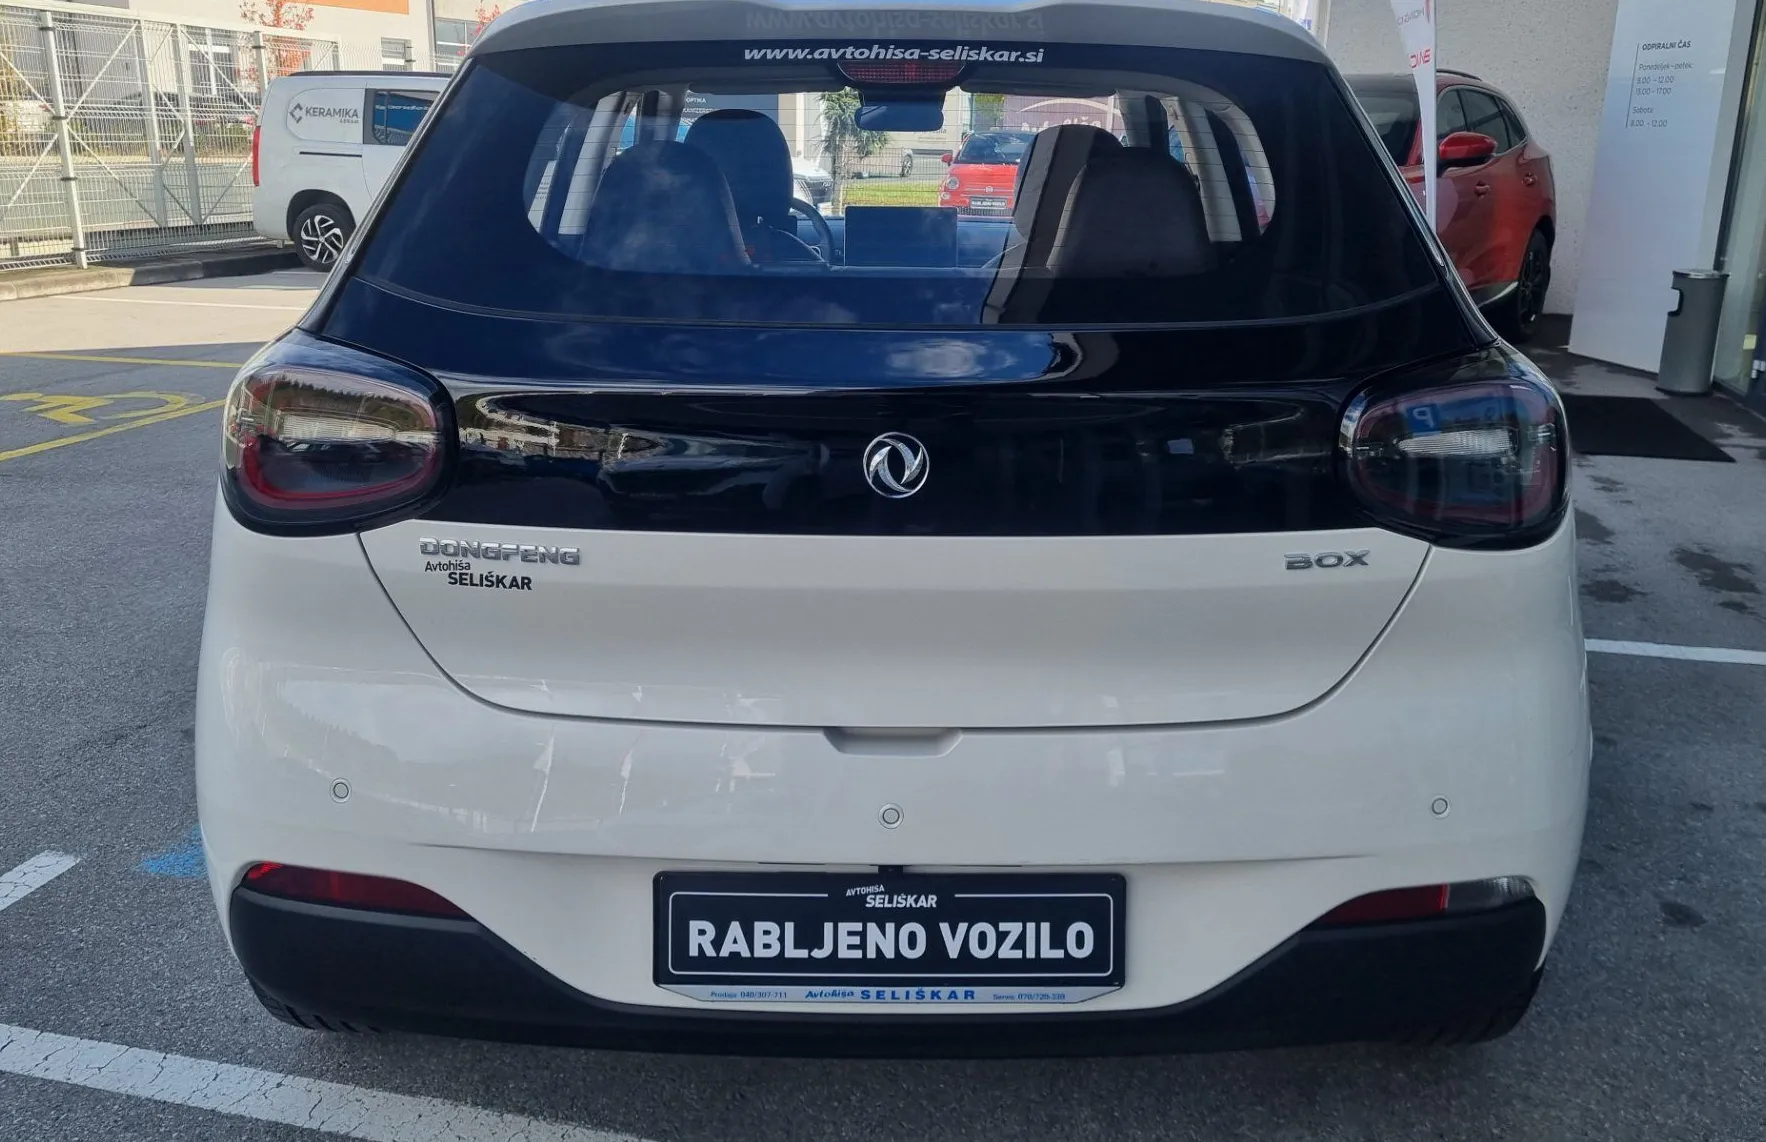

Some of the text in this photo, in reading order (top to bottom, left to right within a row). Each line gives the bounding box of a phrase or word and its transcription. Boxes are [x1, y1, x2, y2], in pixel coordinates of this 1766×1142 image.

[744, 44, 1044, 63] www.avtohisa-seliskar.si
[1642, 39, 1691, 51] ODPIRALNI ČAS
[305, 106, 359, 119] KERAMIKA
[419, 537, 580, 566] DONGFENG
[1284, 549, 1370, 570] BOX
[865, 893, 938, 908] SELIŠKAR
[688, 920, 1094, 959] RABLJENO VOZILO
[860, 987, 975, 1000] SELIŠKAR
